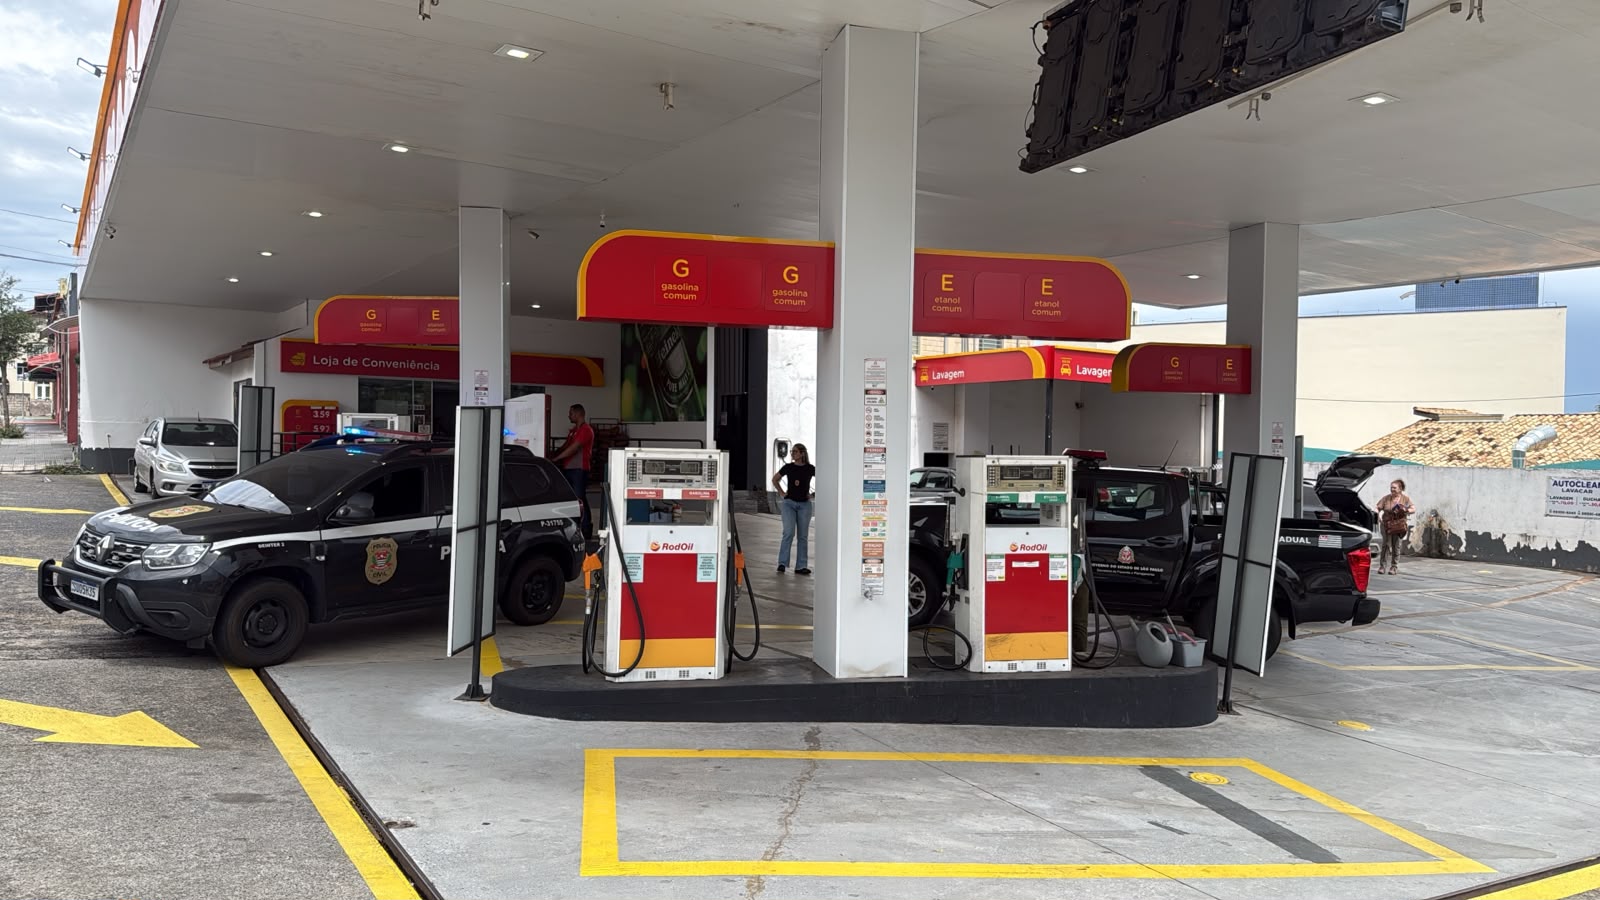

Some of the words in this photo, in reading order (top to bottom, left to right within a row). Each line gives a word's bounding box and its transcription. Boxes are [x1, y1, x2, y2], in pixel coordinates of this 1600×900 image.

[672, 258, 690, 278] G
[782, 266, 799, 284] G
[661, 282, 699, 292] gasolina
[941, 274, 954, 292] E
[1041, 278, 1054, 296] E
[663, 292, 697, 302] comum
[772, 288, 808, 298] gasolina
[774, 298, 806, 306] comum
[934, 296, 961, 305] etanol
[1034, 300, 1060, 308] etanol
[932, 304, 962, 314] comum
[1032, 308, 1062, 317] comum
[366, 309, 376, 320] G
[432, 310, 440, 320] E
[312, 354, 340, 368] Loja
[342, 356, 358, 367] de
[362, 356, 440, 371] Conveniência
[1170, 356, 1180, 368] G
[1226, 358, 1233, 370] E
[932, 368, 965, 381] Lavagem
